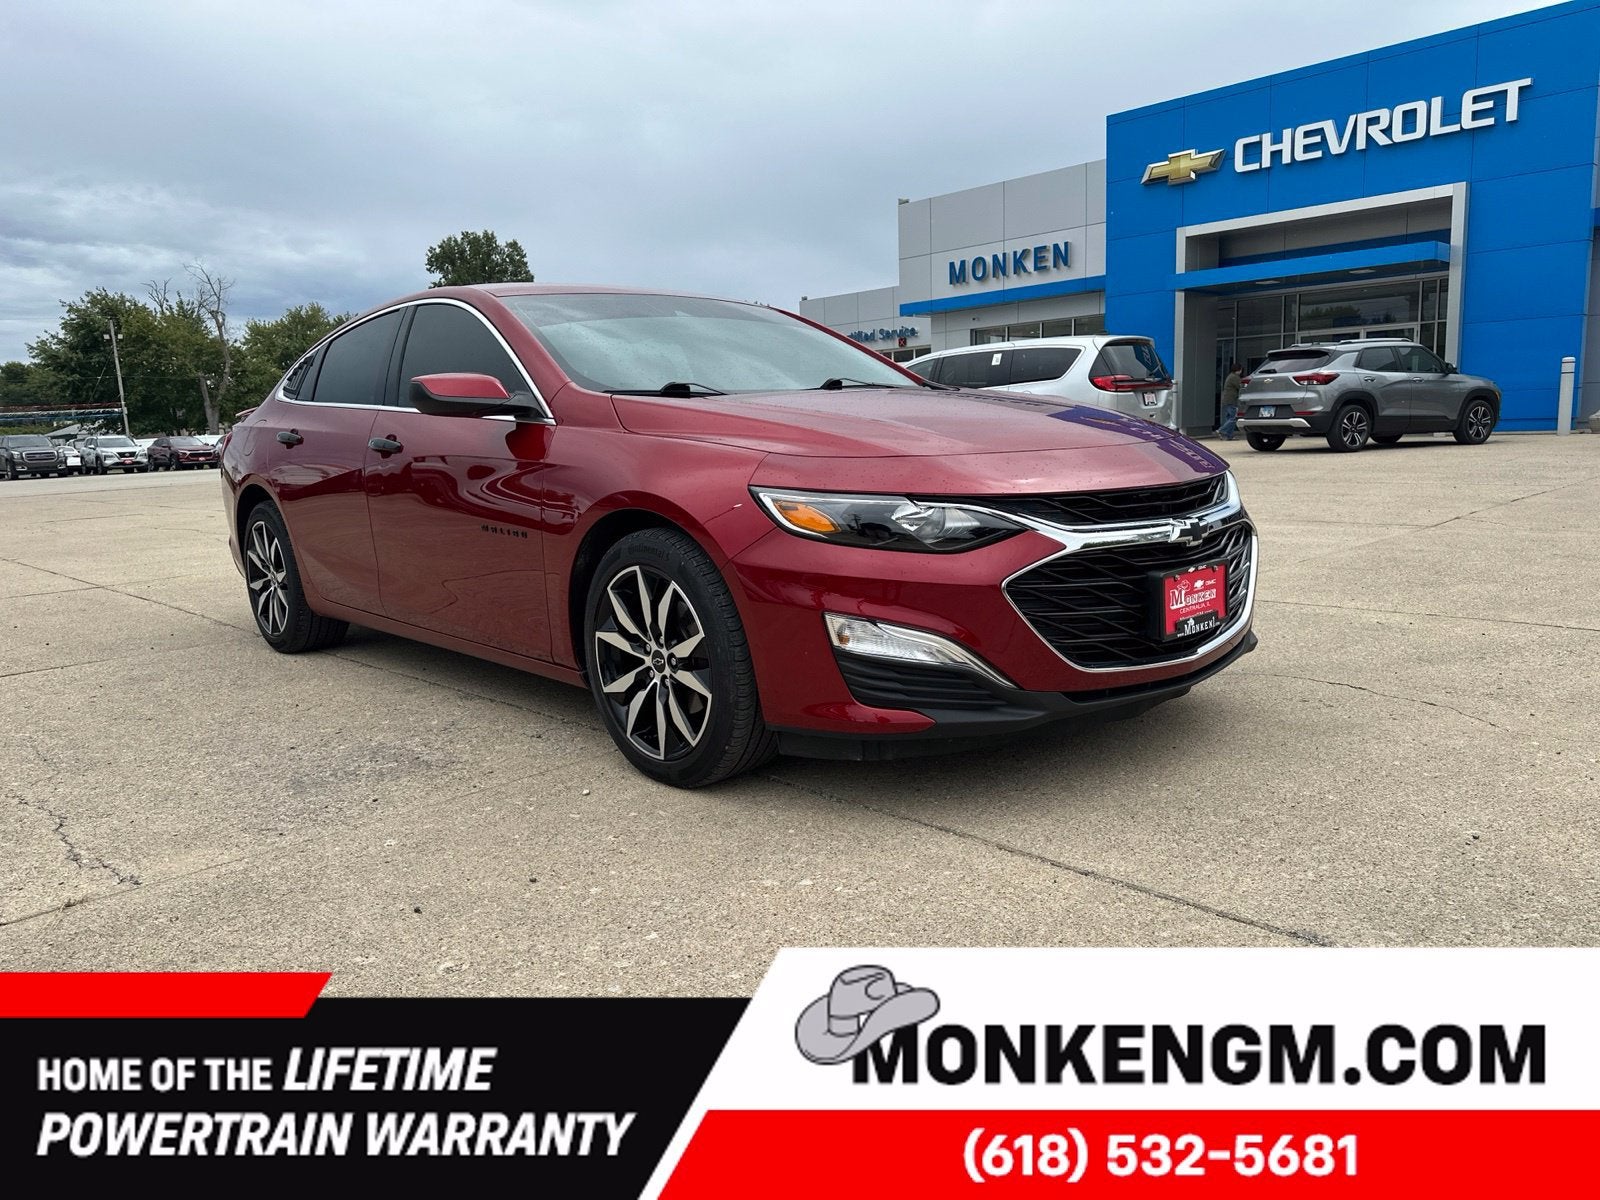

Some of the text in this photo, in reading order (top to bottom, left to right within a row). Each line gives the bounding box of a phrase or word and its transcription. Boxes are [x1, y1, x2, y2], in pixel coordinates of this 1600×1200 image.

[1234, 77, 1534, 173] CHEVROLET
[949, 241, 1071, 286] MONKEN
[879, 326, 914, 340] Service
